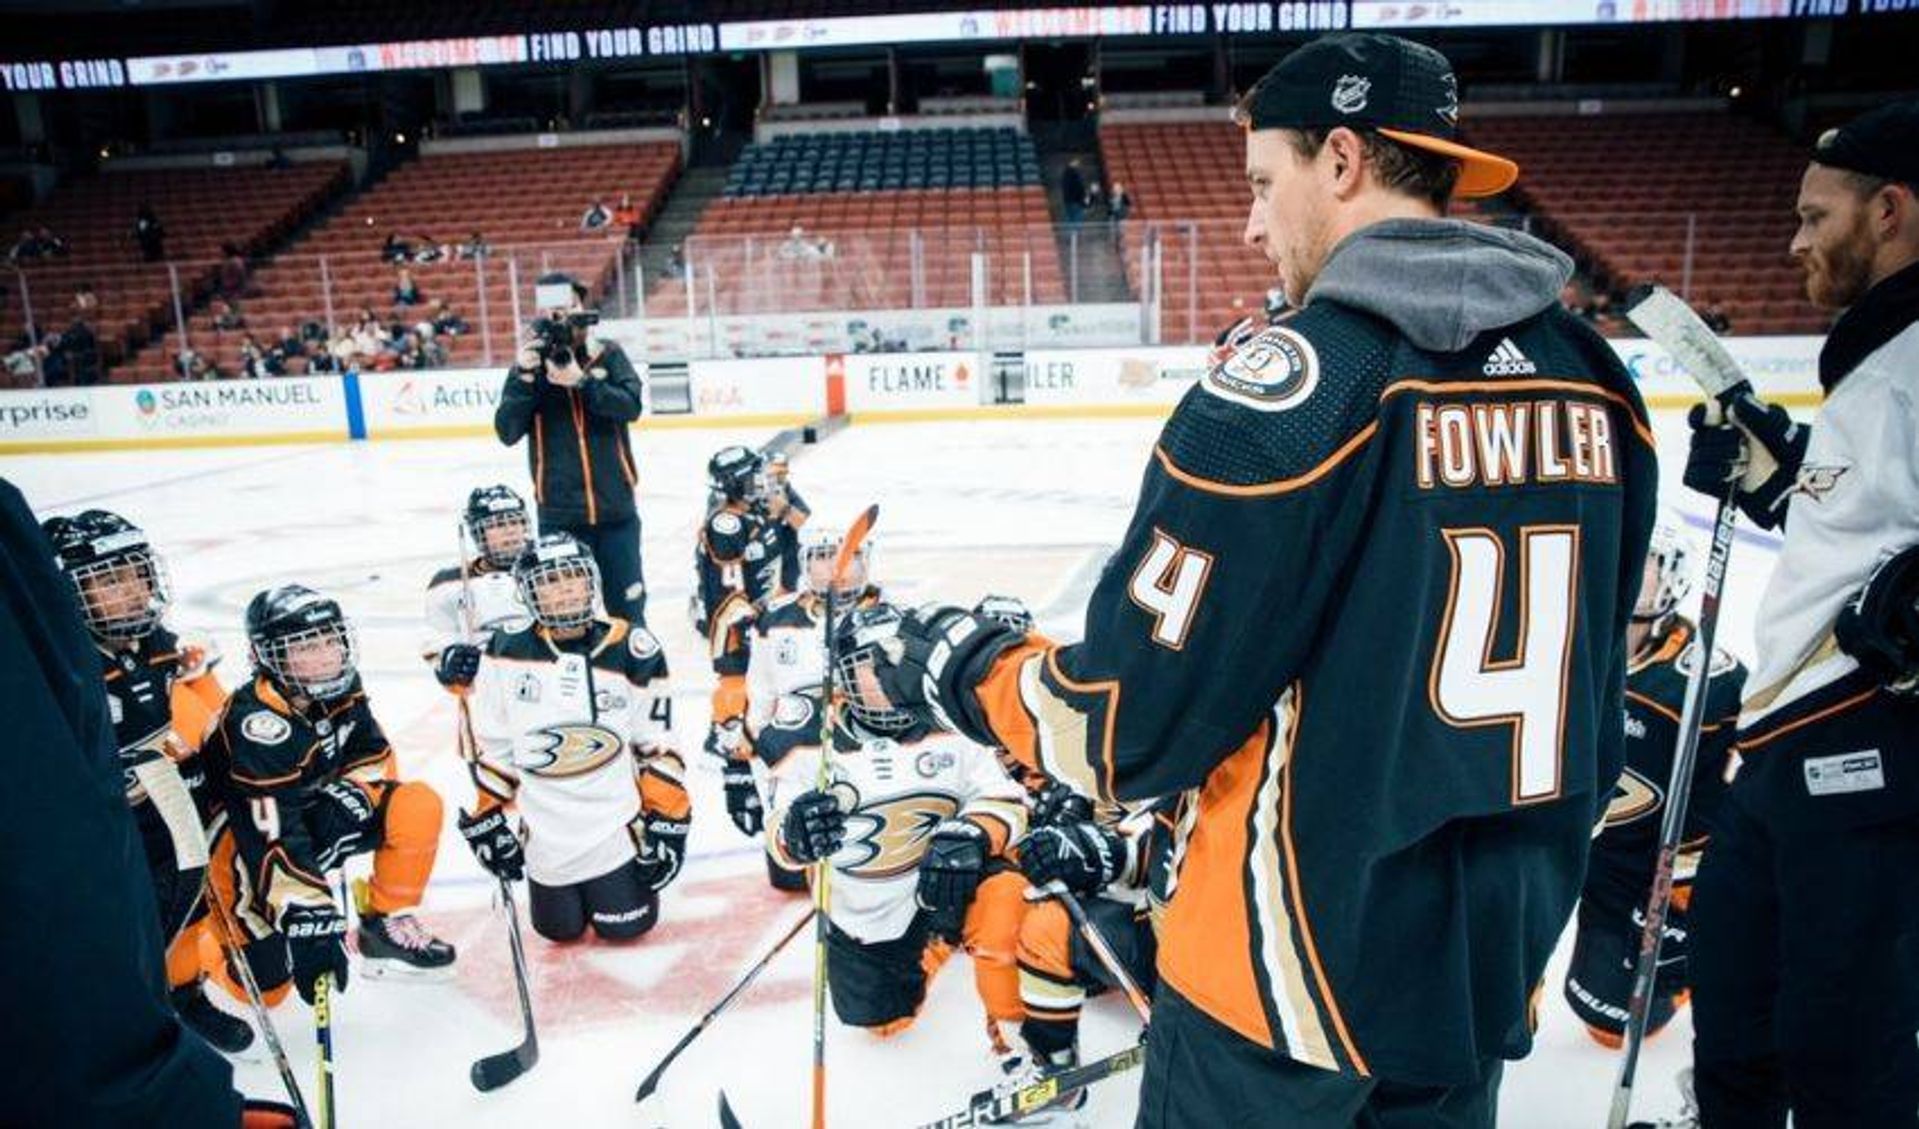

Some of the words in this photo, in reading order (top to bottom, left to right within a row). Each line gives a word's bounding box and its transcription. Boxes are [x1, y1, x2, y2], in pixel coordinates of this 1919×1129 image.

[1156, 4, 1205, 34] FIND
[1212, 3, 1272, 33] YOUR
[1279, 2, 1347, 31] GRIND
[531, 31, 580, 62] FIND
[586, 28, 642, 58] YOUR
[648, 24, 714, 54] GRIND
[0, 61, 56, 90] YOUR
[60, 58, 124, 88] GRIND
[869, 364, 946, 392] FLAME
[1025, 362, 1074, 389] ILER
[1483, 359, 1536, 376] adidas
[162, 388, 211, 411] SAN
[218, 383, 320, 407] MANUEL
[434, 381, 498, 408] Activ
[0, 397, 88, 428] rprise
[1416, 401, 1617, 488] FOWLER
[1704, 503, 1736, 596] BAUER
[1127, 525, 1215, 651] 4
[1428, 524, 1580, 806] 4
[649, 696, 671, 730] 4
[251, 797, 280, 842] 4
[288, 921, 347, 937] BAUE
